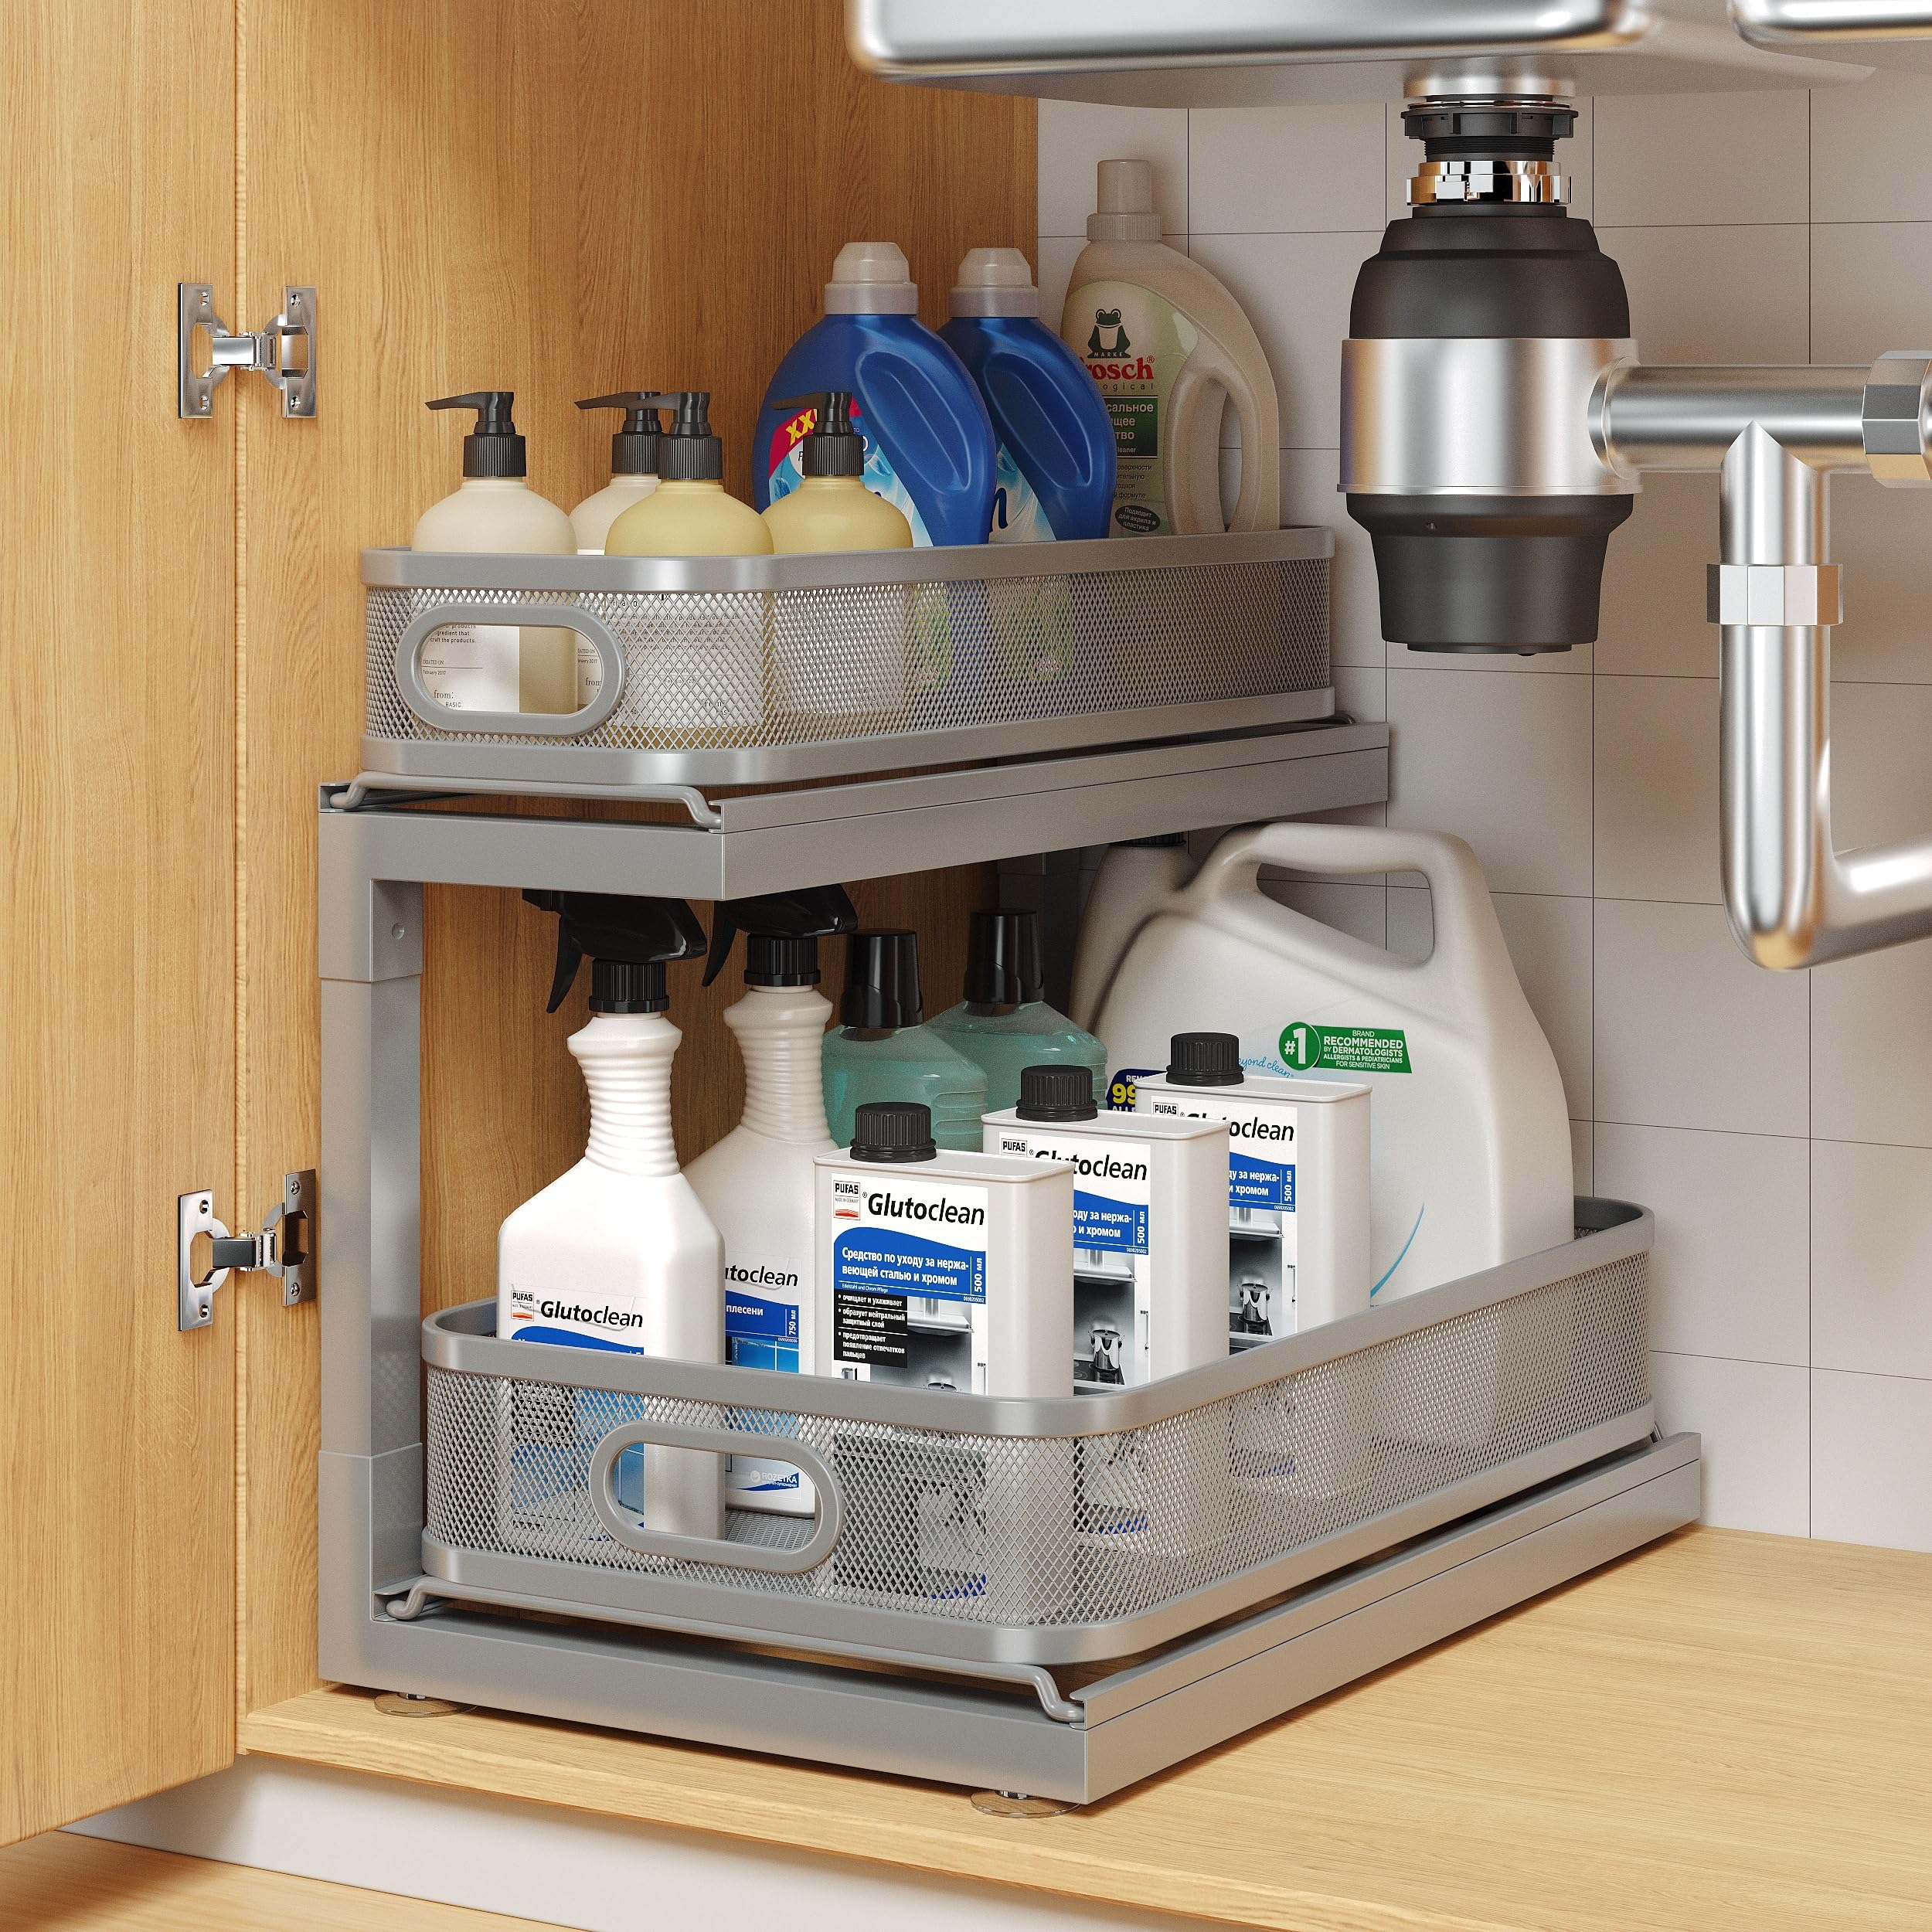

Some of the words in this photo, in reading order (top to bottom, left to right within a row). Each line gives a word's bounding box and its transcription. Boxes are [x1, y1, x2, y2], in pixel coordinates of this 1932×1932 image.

[1080, 356, 1154, 379] rosch
[1111, 418, 1135, 427] щее
[1124, 507, 1151, 518] Подходит
[1123, 522, 1149, 531] пластика
[1130, 516, 1151, 525] акрила
[1284, 1027, 1307, 1064] #1
[1324, 1036, 1403, 1049] RECOMMENDED
[1332, 1046, 1403, 1057] DERMATOLOGISTS
[1267, 1058, 1290, 1078] clean
[1155, 1104, 1177, 1114] PUFAS
[1003, 1141, 1026, 1152] PUFAS
[1238, 1171, 1248, 1179] за
[1250, 1172, 1280, 1183] нержа-
[1287, 1170, 1292, 1182] мл
[835, 1182, 859, 1195] PUFAS
[1235, 1185, 1269, 1196] хромом
[1284, 1184, 1292, 1202] 500
[869, 1192, 985, 1226] Glutoclean
[1090, 1212, 1100, 1220] за
[1101, 1213, 1132, 1224] нержа-
[1140, 1211, 1145, 1223] мл
[1086, 1226, 1121, 1238] хромом
[1137, 1226, 1145, 1244] 500
[842, 1247, 883, 1263] Средство
[884, 1253, 896, 1263] по
[897, 1254, 923, 1268] уходу
[925, 1258, 935, 1267] за
[937, 1258, 969, 1270] нержа-
[976, 1257, 982, 1271] мл
[842, 1265, 879, 1278] веющей
[879, 1270, 912, 1281] сталью
[913, 1273, 920, 1281] и
[921, 1273, 957, 1286] хромом
[512, 1292, 533, 1301] PUFAS
[842, 1294, 867, 1304] очищает
[872, 1298, 903, 1307] ухаживает
[540, 1301, 643, 1328] Glutoclean
[726, 1304, 764, 1316] плесени
[791, 1310, 796, 1320] мл
[842, 1308, 867, 1318] образует
[868, 1311, 906, 1321] нейтральный
[842, 1318, 871, 1327] защитный
[842, 1332, 886, 1342] предотвращает
[842, 1341, 872, 1350] появление
[872, 1345, 905, 1354] отпечатков
[842, 1350, 866, 1360] пальцев
[762, 1472, 798, 1484] ROZETKA
